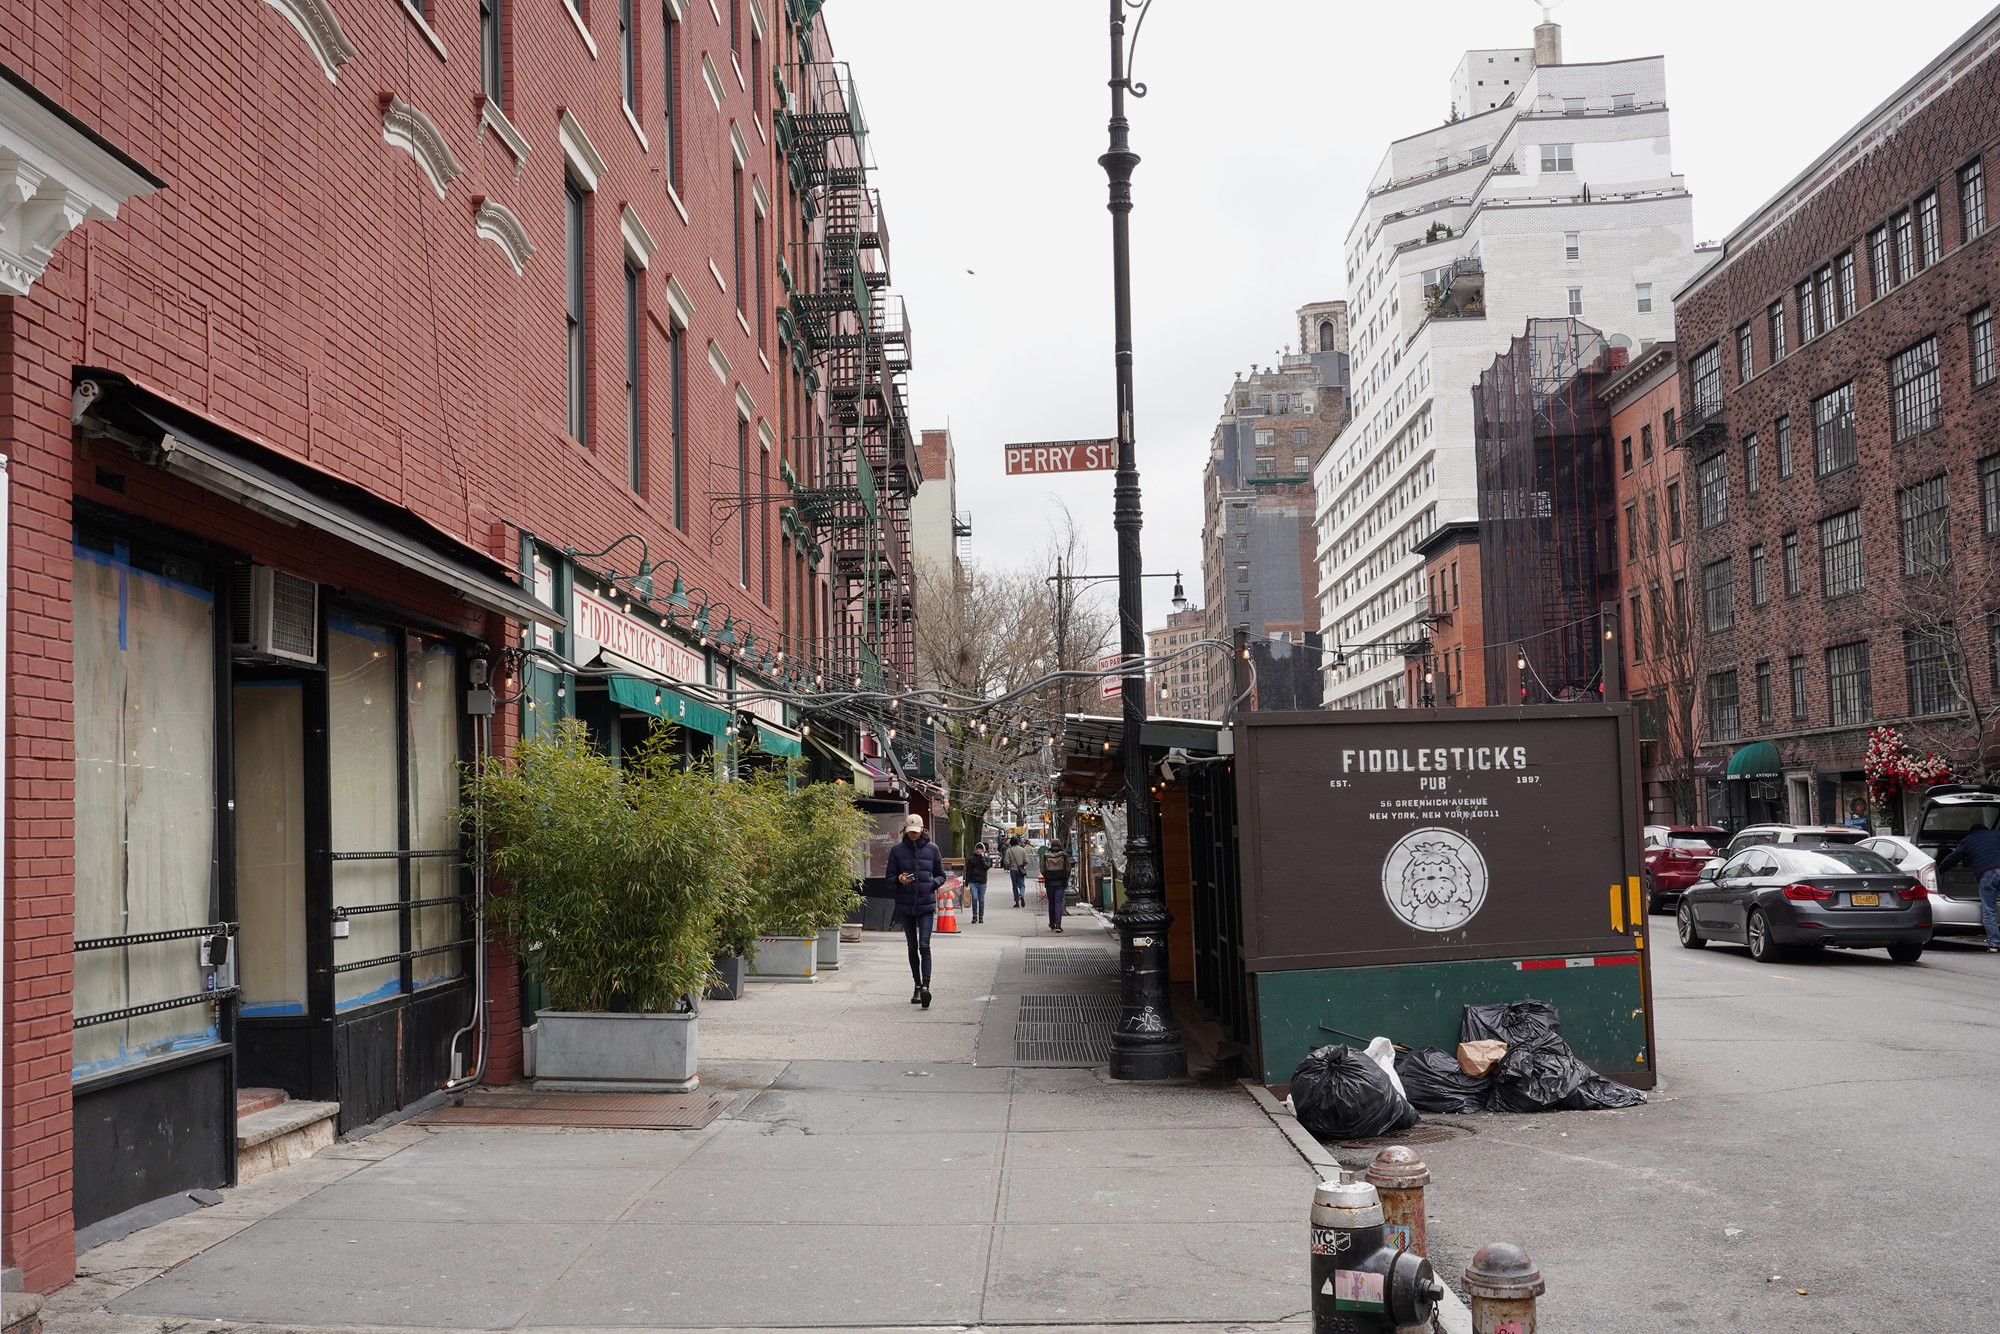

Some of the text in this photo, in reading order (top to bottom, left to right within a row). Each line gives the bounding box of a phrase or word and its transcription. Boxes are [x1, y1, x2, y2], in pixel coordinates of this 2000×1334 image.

[1007, 445, 1110, 473] PERRY ST
[580, 599, 656, 667] FIDDLESTICKS
[1101, 660, 1109, 668] NO
[1342, 747, 1527, 773] FIDDLESTICKS
[1330, 776, 1540, 790] EST. PUB 1997
[1395, 799, 1449, 808] GREENWICH
[1452, 798, 1488, 806] AVENUE
[1369, 810, 1500, 820] NEW YORK, NEW YORK 10011
